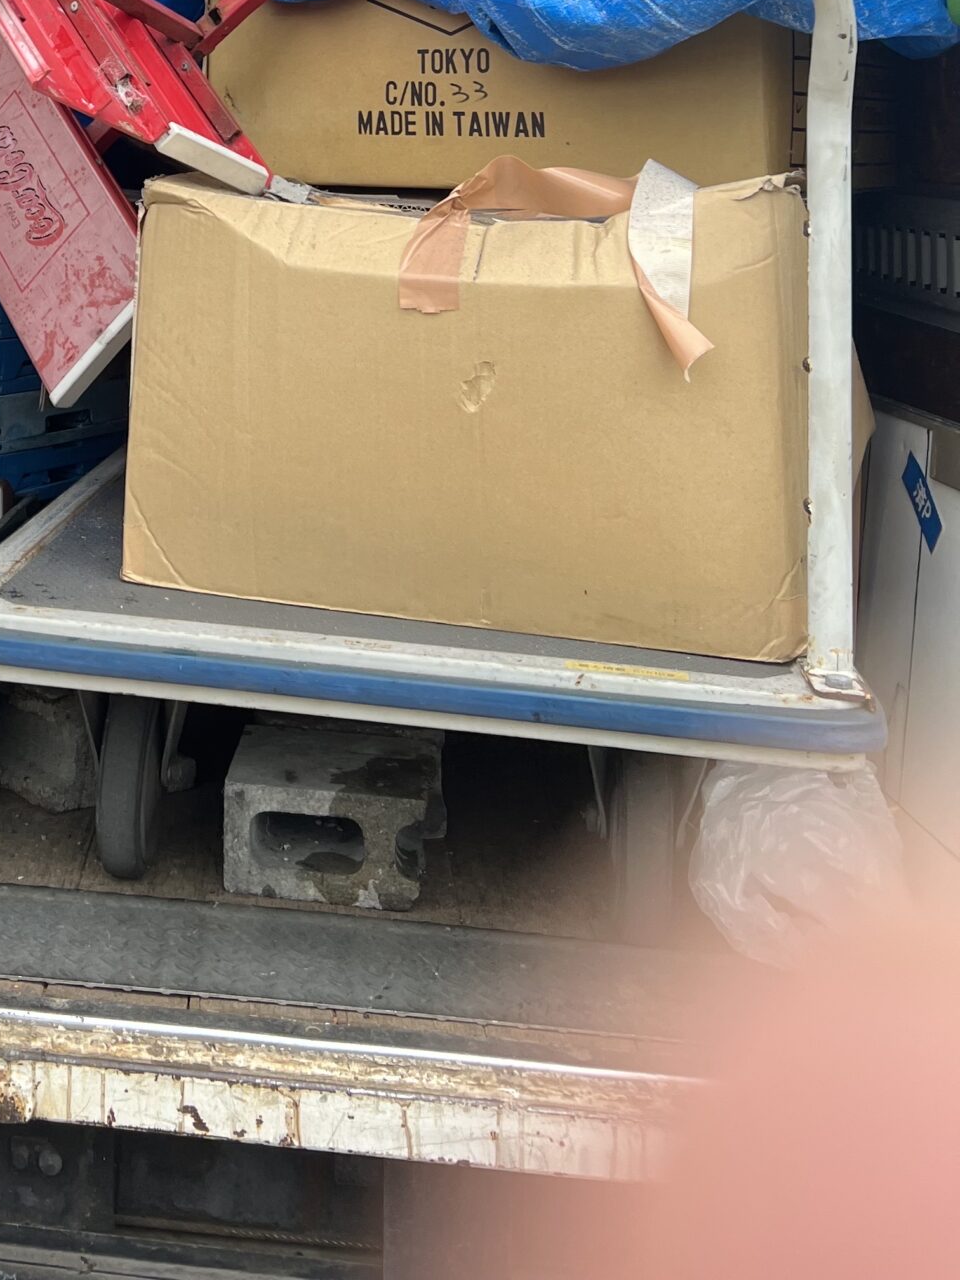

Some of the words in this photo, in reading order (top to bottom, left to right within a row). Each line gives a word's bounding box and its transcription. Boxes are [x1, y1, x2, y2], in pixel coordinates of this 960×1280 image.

[417, 48, 490, 74] TOKYO
[385, 80, 446, 107] C/NO.
[449, 80, 488, 104] 33
[357, 110, 417, 136] MADE
[425, 110, 444, 136] IN
[452, 111, 545, 138] TAIWAN
